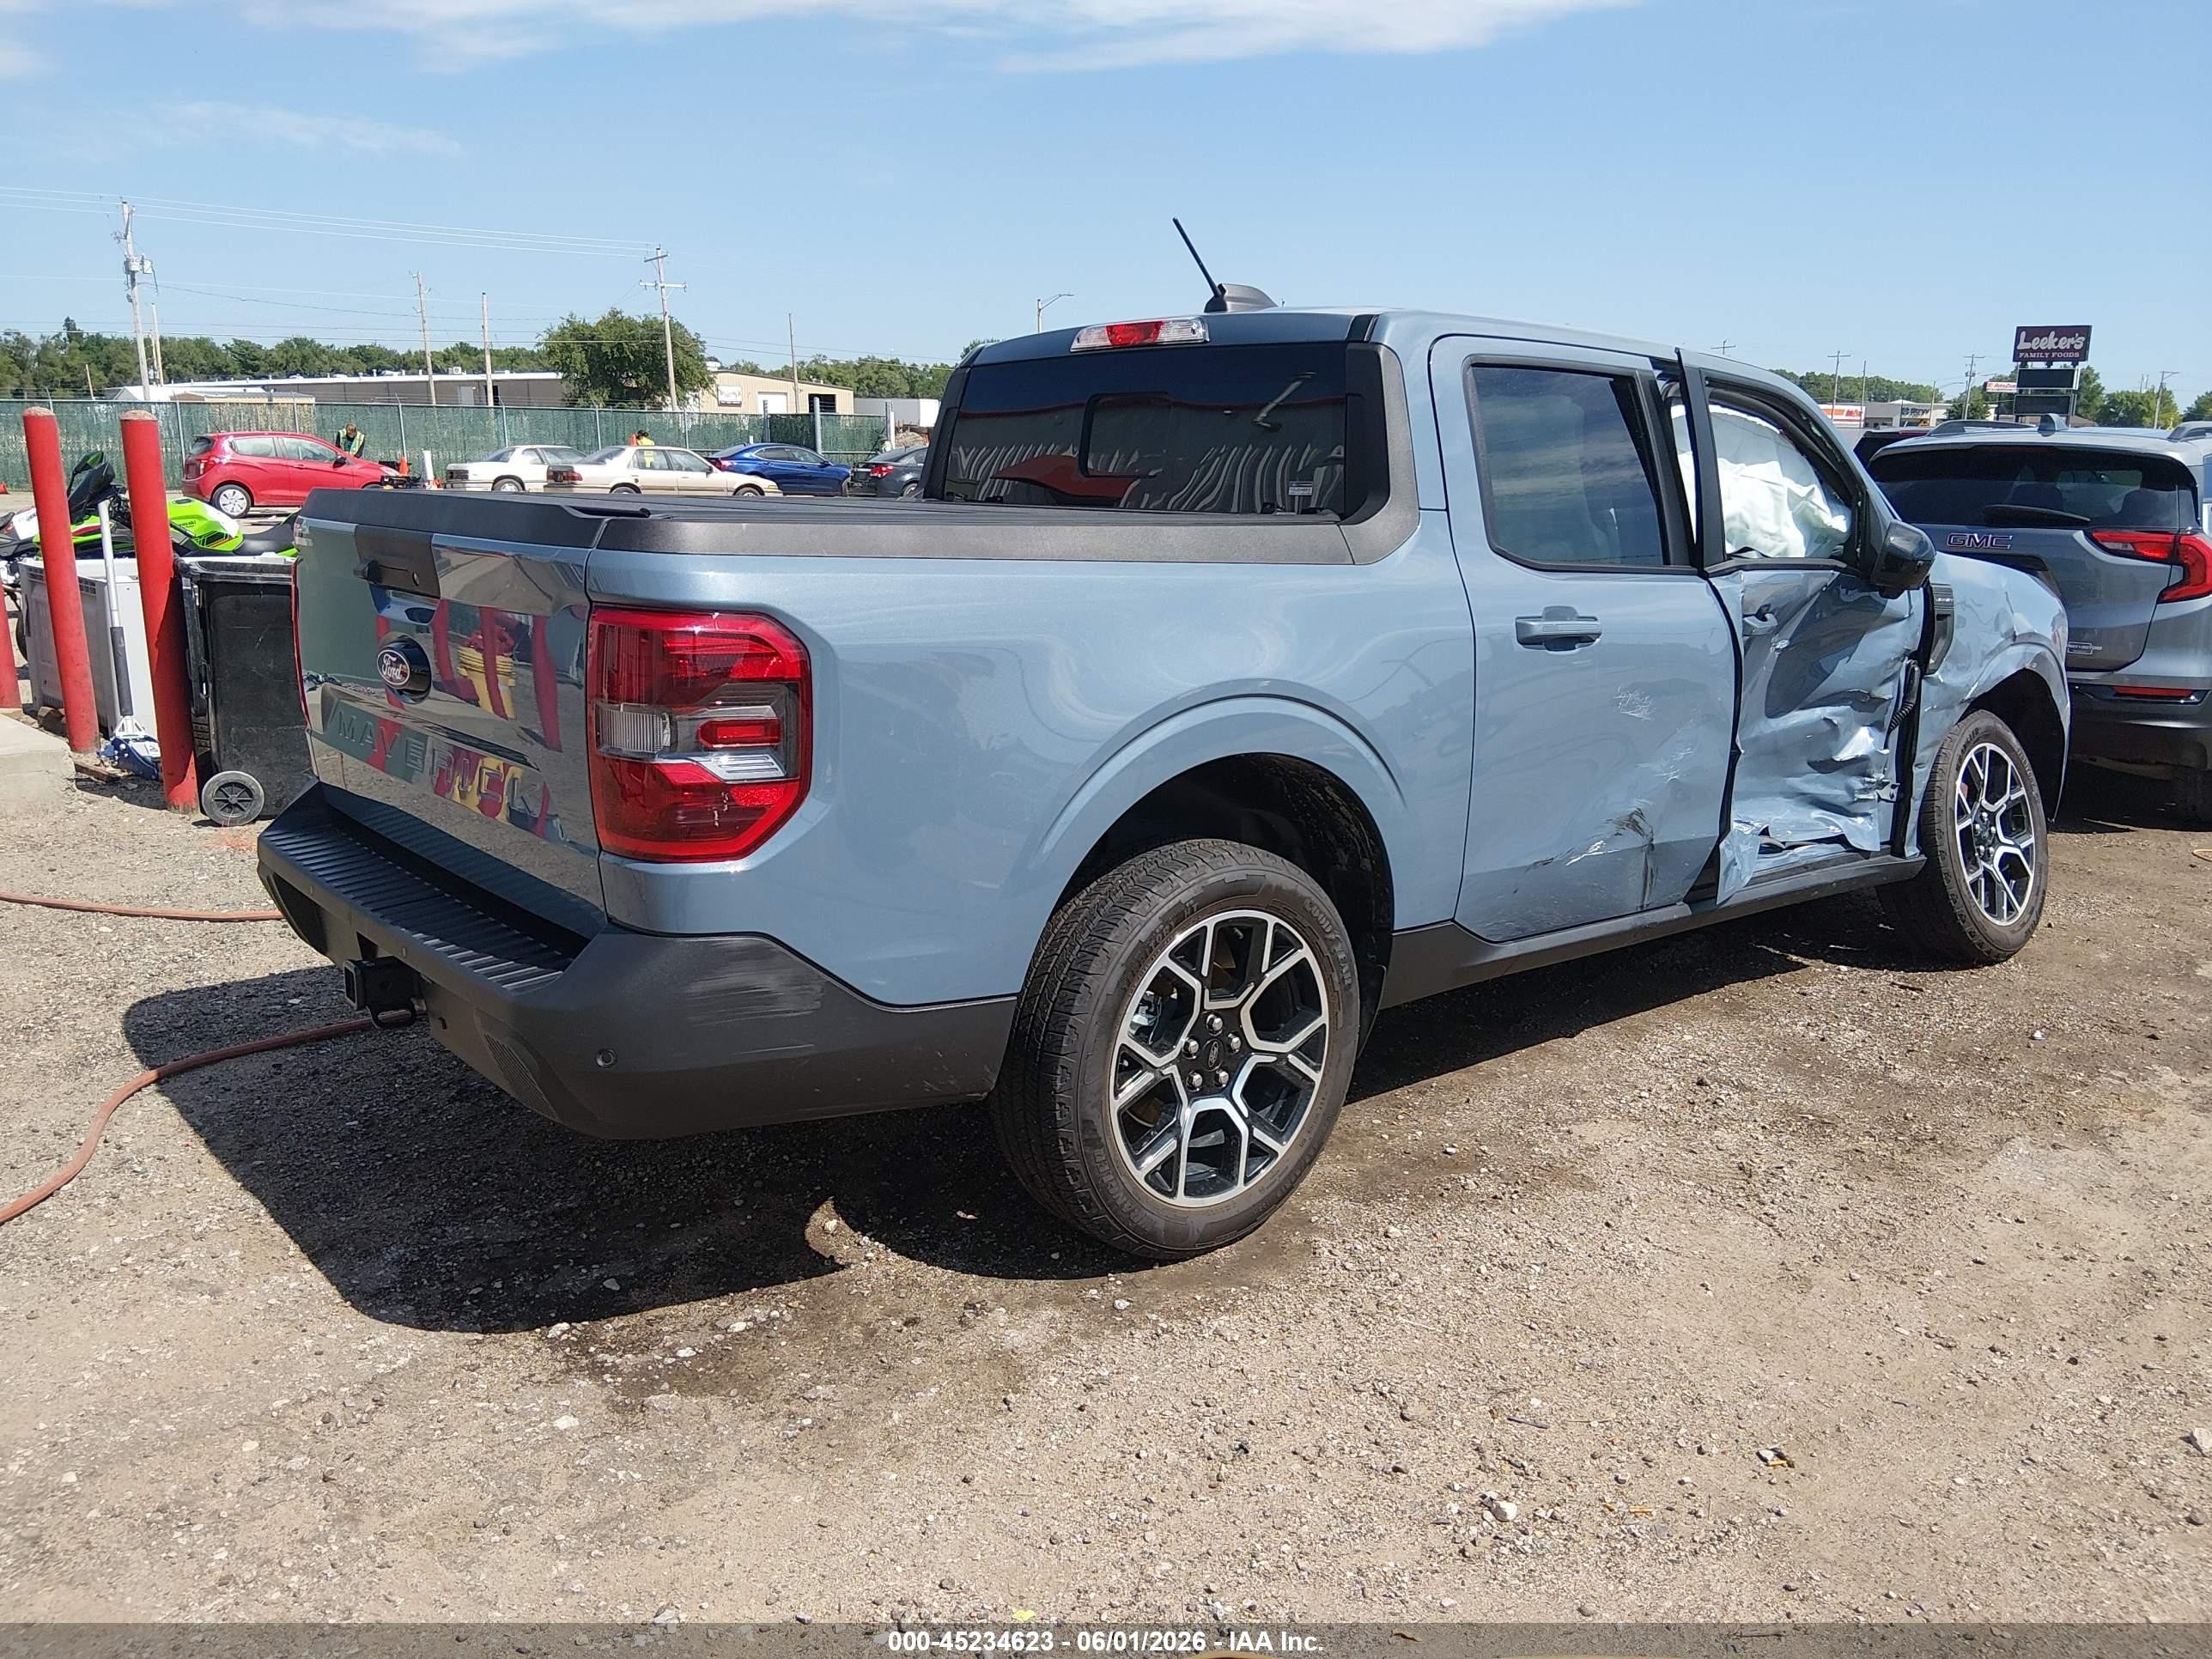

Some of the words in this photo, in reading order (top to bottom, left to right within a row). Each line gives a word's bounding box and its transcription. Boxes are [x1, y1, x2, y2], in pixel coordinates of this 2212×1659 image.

[2016, 331, 2086, 349] Leeker's
[1947, 532, 2013, 550] GMC
[338, 710, 542, 818] MAVERICK
